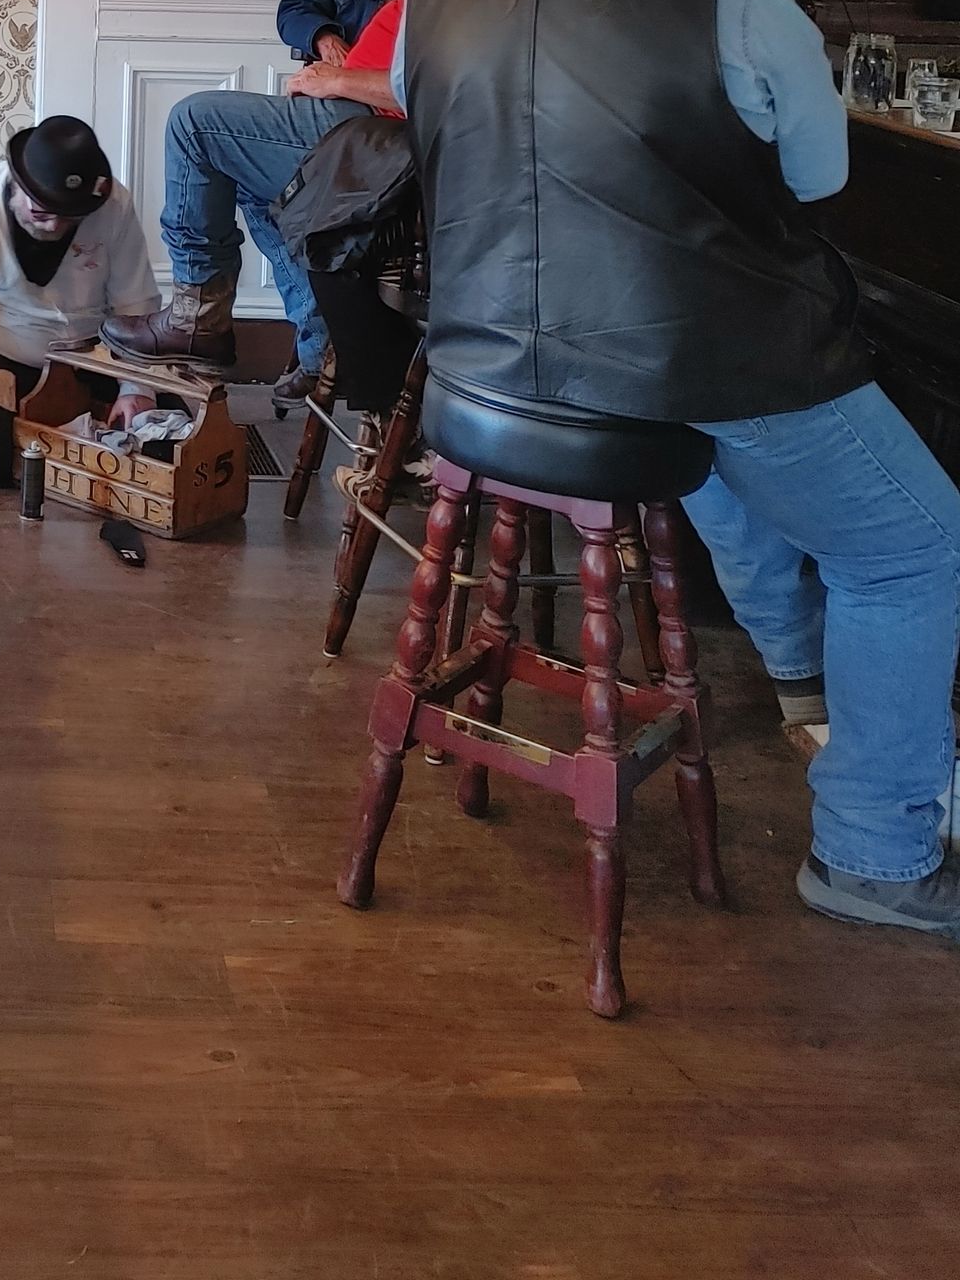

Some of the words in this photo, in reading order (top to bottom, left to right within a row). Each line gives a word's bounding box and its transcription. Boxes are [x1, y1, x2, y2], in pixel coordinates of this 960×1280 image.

[37, 431, 149, 486] SHOE
[194, 450, 234, 488] $5
[50, 466, 163, 524] HINE
